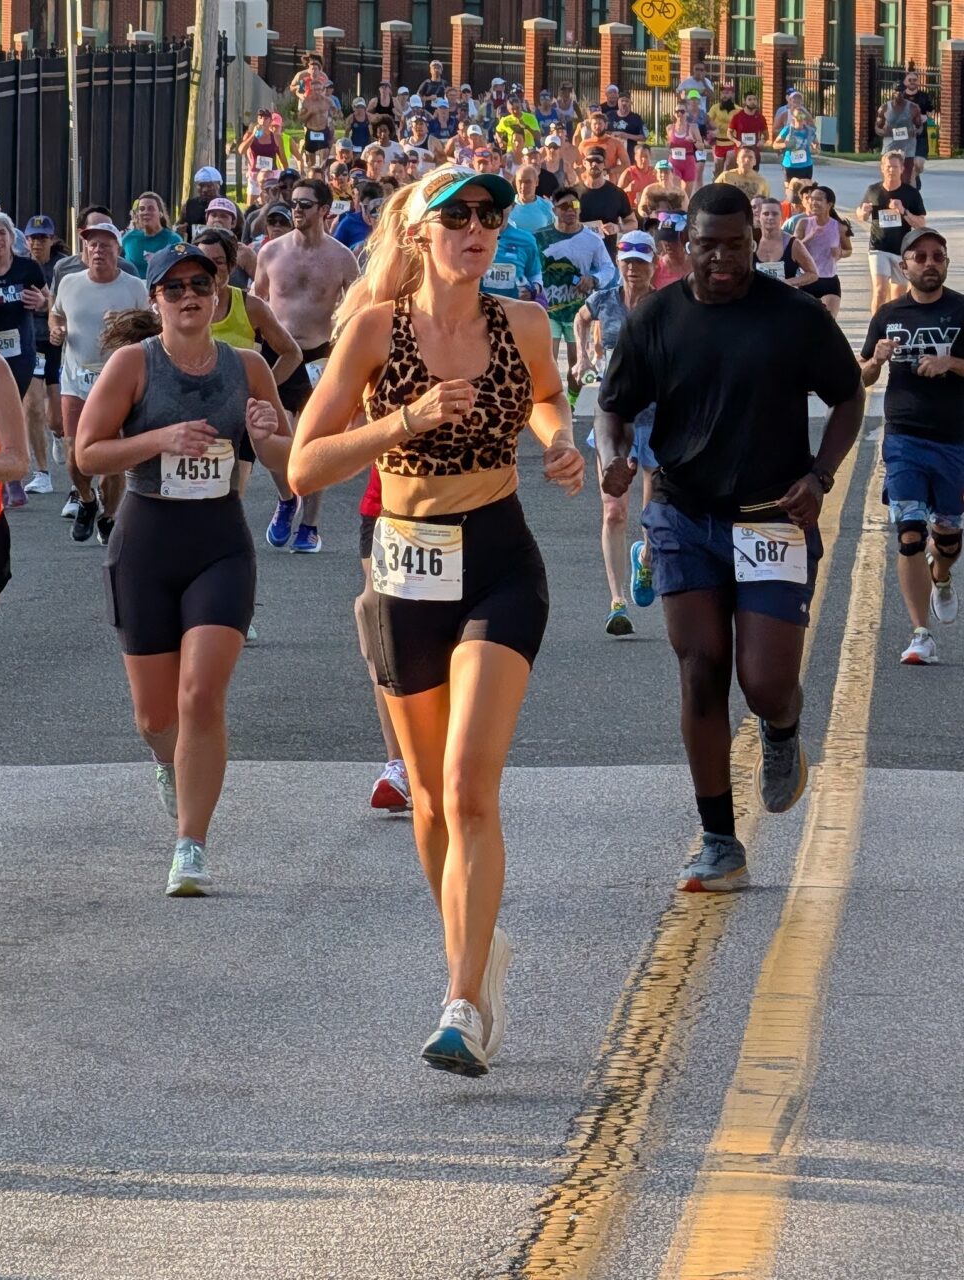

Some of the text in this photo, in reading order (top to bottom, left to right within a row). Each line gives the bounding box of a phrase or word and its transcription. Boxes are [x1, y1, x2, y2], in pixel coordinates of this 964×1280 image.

[650, 54, 667, 62] SHARE
[651, 74, 666, 82] ROAD
[490, 271, 510, 281] 4051
[84, 372, 100, 384] 47
[176, 457, 220, 480] 4531
[755, 541, 789, 562] 687
[388, 543, 443, 577] 3416
